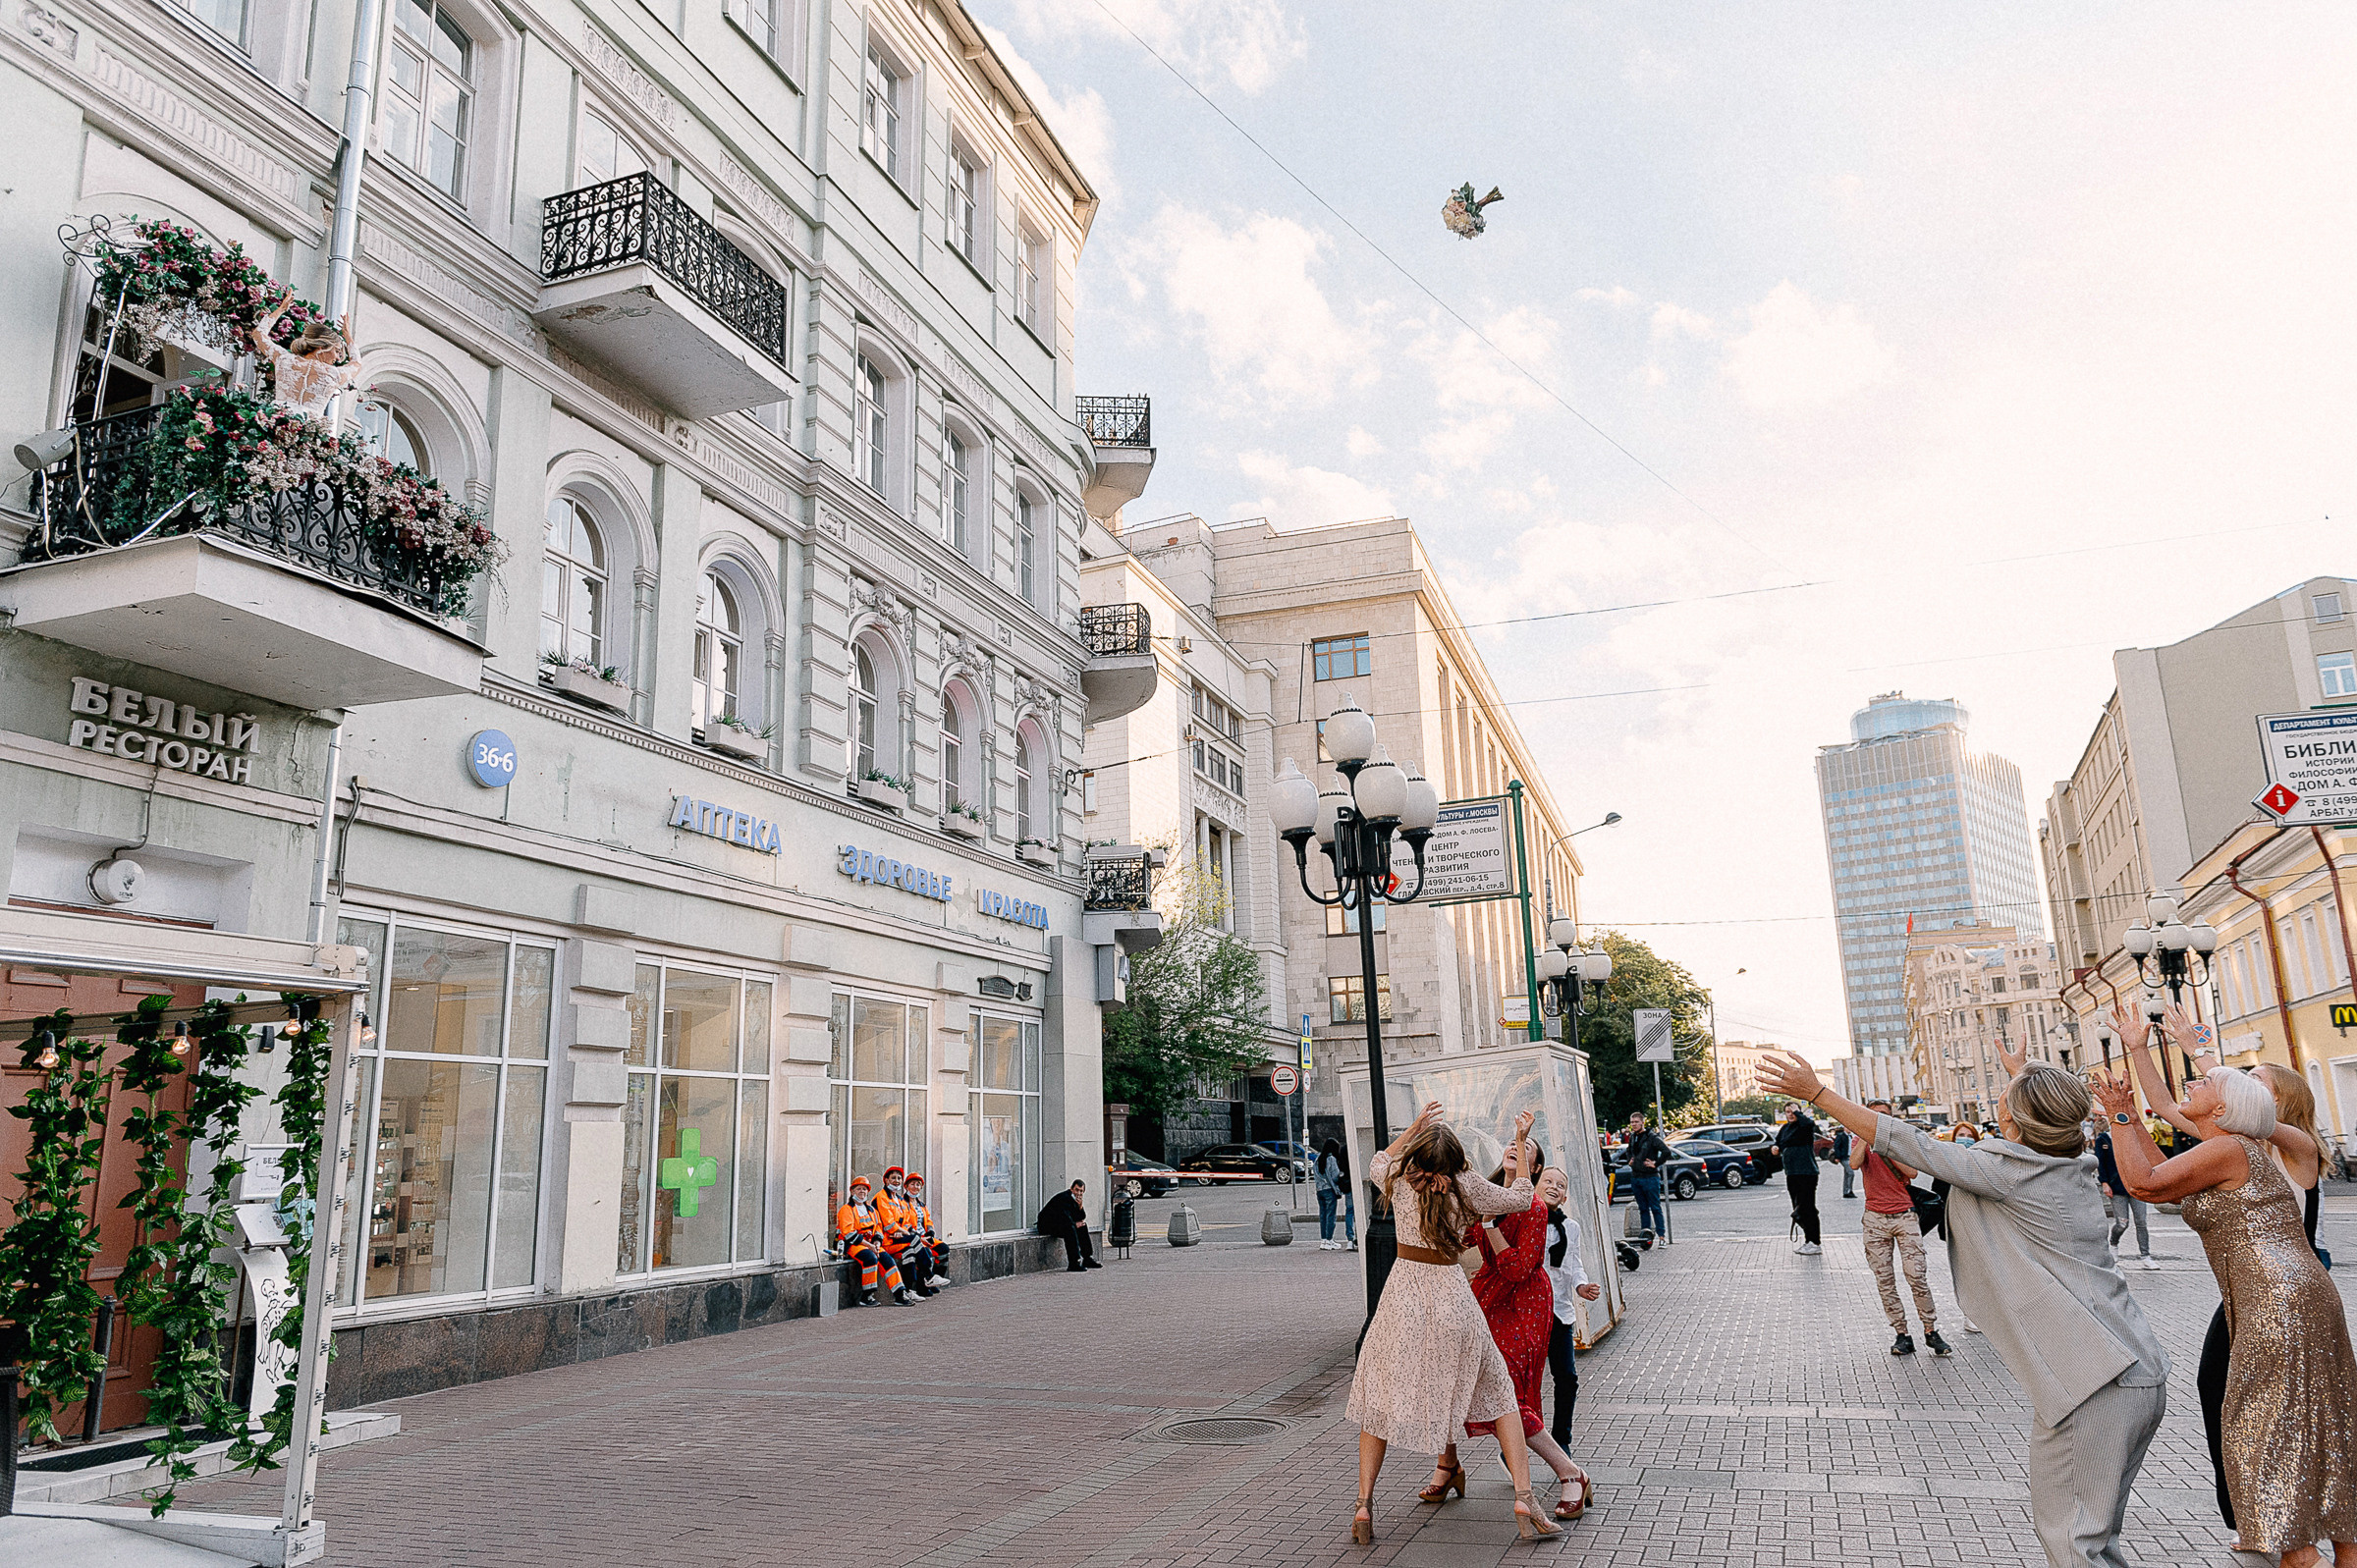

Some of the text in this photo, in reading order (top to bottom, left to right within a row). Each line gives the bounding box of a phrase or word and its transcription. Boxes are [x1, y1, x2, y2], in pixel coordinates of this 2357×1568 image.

[71, 676, 261, 754] БЕЛЫЙ
[2274, 719, 2331, 731] ДЕПАРТАМЕНТ
[69, 719, 252, 784] РЕСТОРАН
[2284, 740, 2357, 759] БИБЛИ
[2305, 757, 2355, 767] ИСТОРИИ
[2332, 779, 2345, 787] А.
[2323, 797, 2330, 806] 8
[2310, 807, 2345, 818] АРБАТ
[673, 795, 783, 854] АПТЕКА
[1431, 841, 1459, 852] ЦЕНТР
[1436, 848, 1500, 863] ТВОРЧЕСКОГО
[842, 844, 953, 902] ЗДОРОВЬЕ
[1423, 862, 1469, 875] РАЗВИТИЯ
[1425, 874, 1490, 889] (499) 241-06-15
[1398, 886, 1452, 898] ГЛАОВСКИЙ
[981, 889, 1050, 931] КРАСОТА
